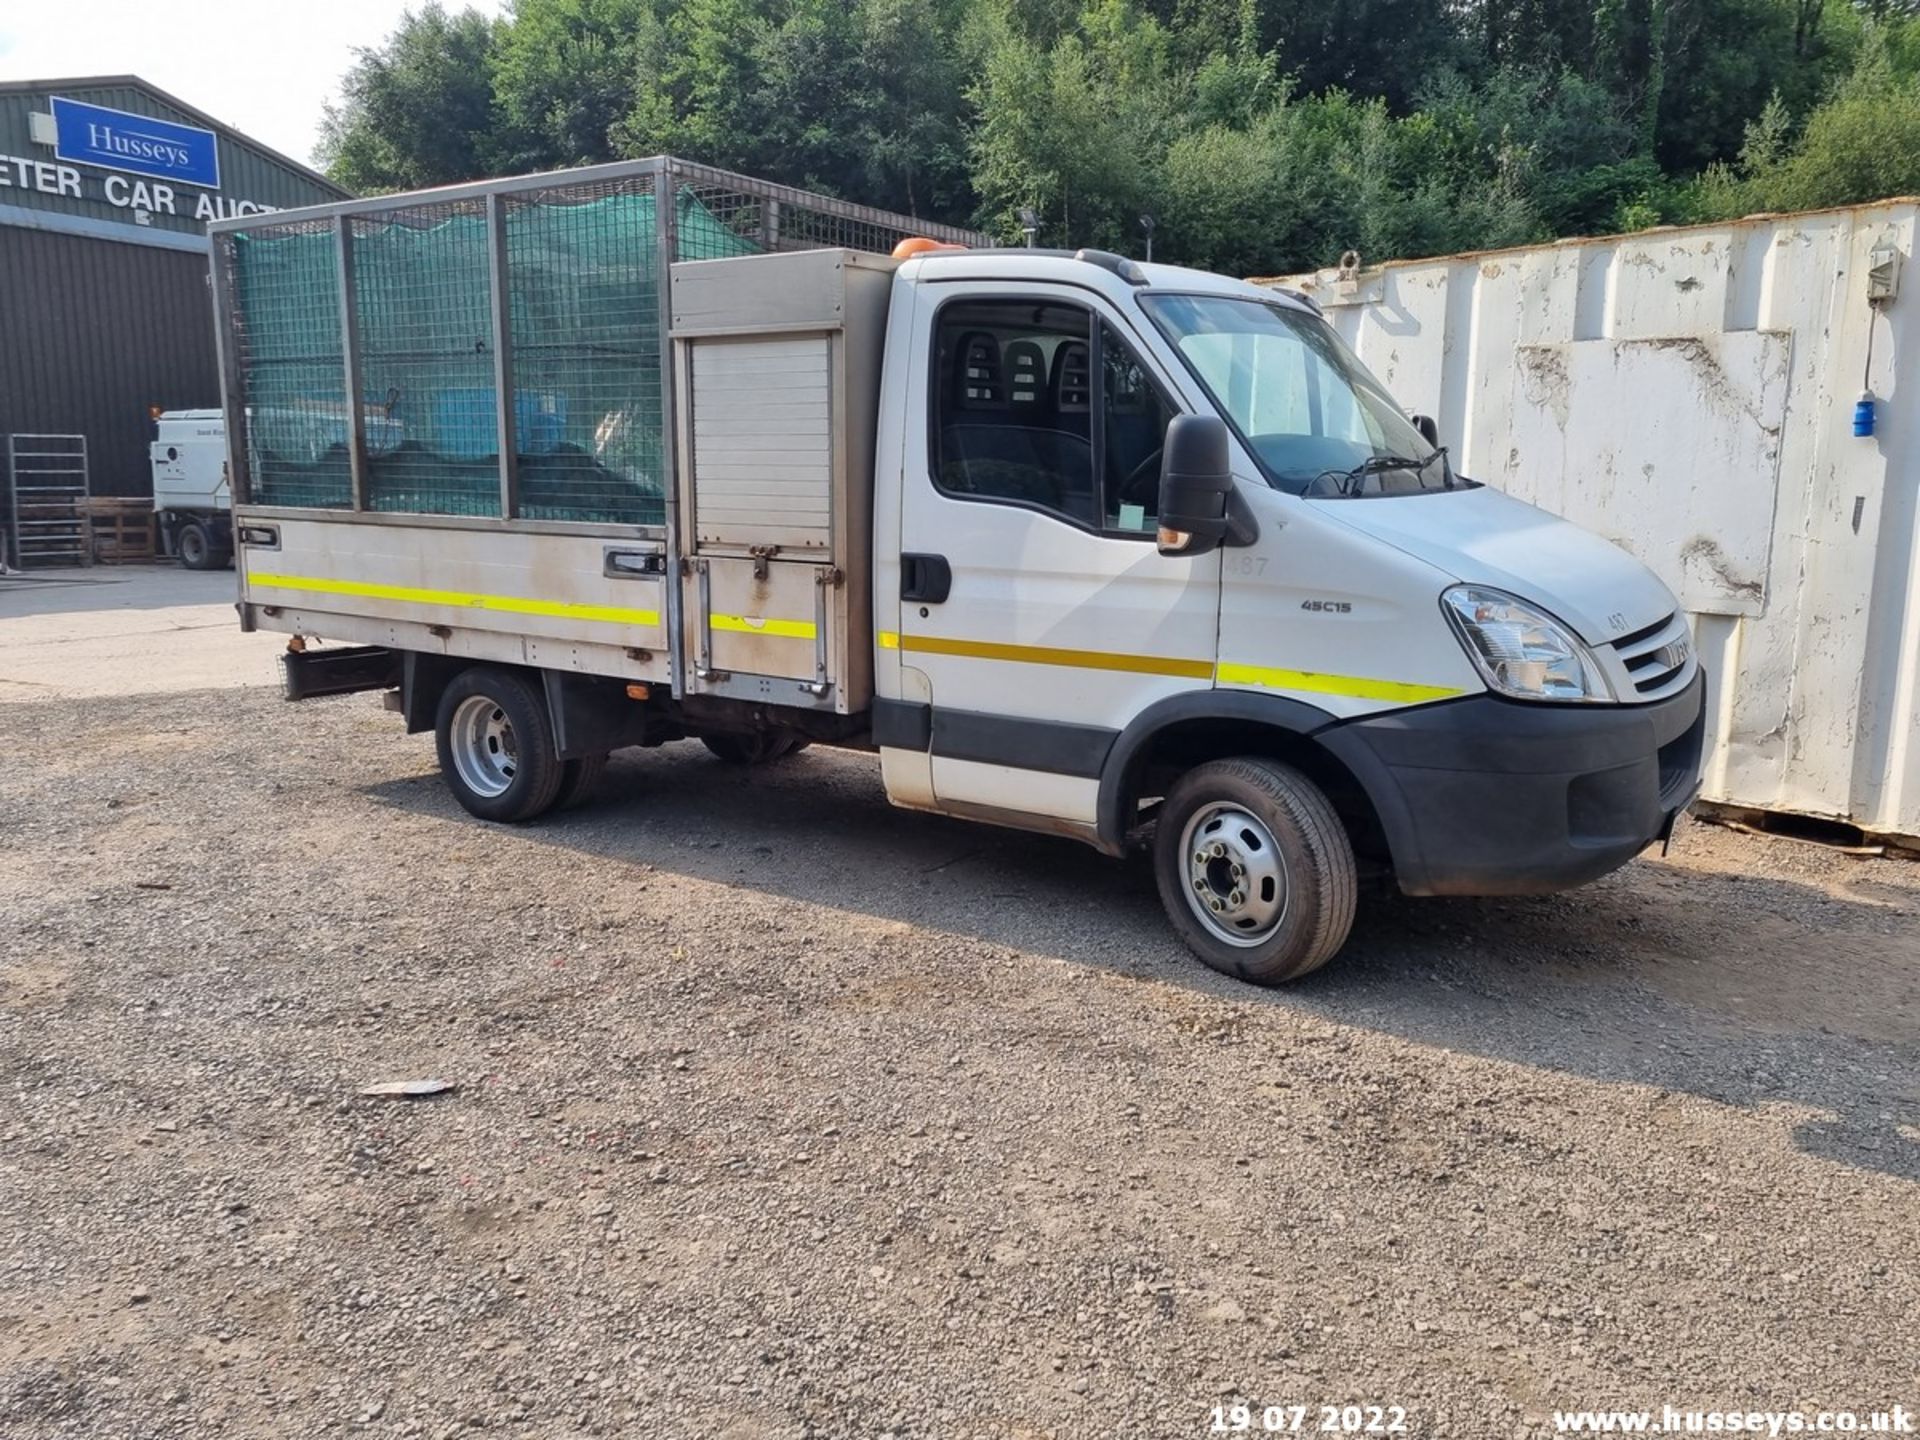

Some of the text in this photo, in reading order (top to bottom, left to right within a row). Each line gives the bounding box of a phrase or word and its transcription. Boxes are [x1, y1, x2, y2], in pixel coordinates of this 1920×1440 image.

[88, 122, 190, 168] Husseys
[104, 175, 176, 215] CAR
[1300, 599, 1352, 614] 45C15
